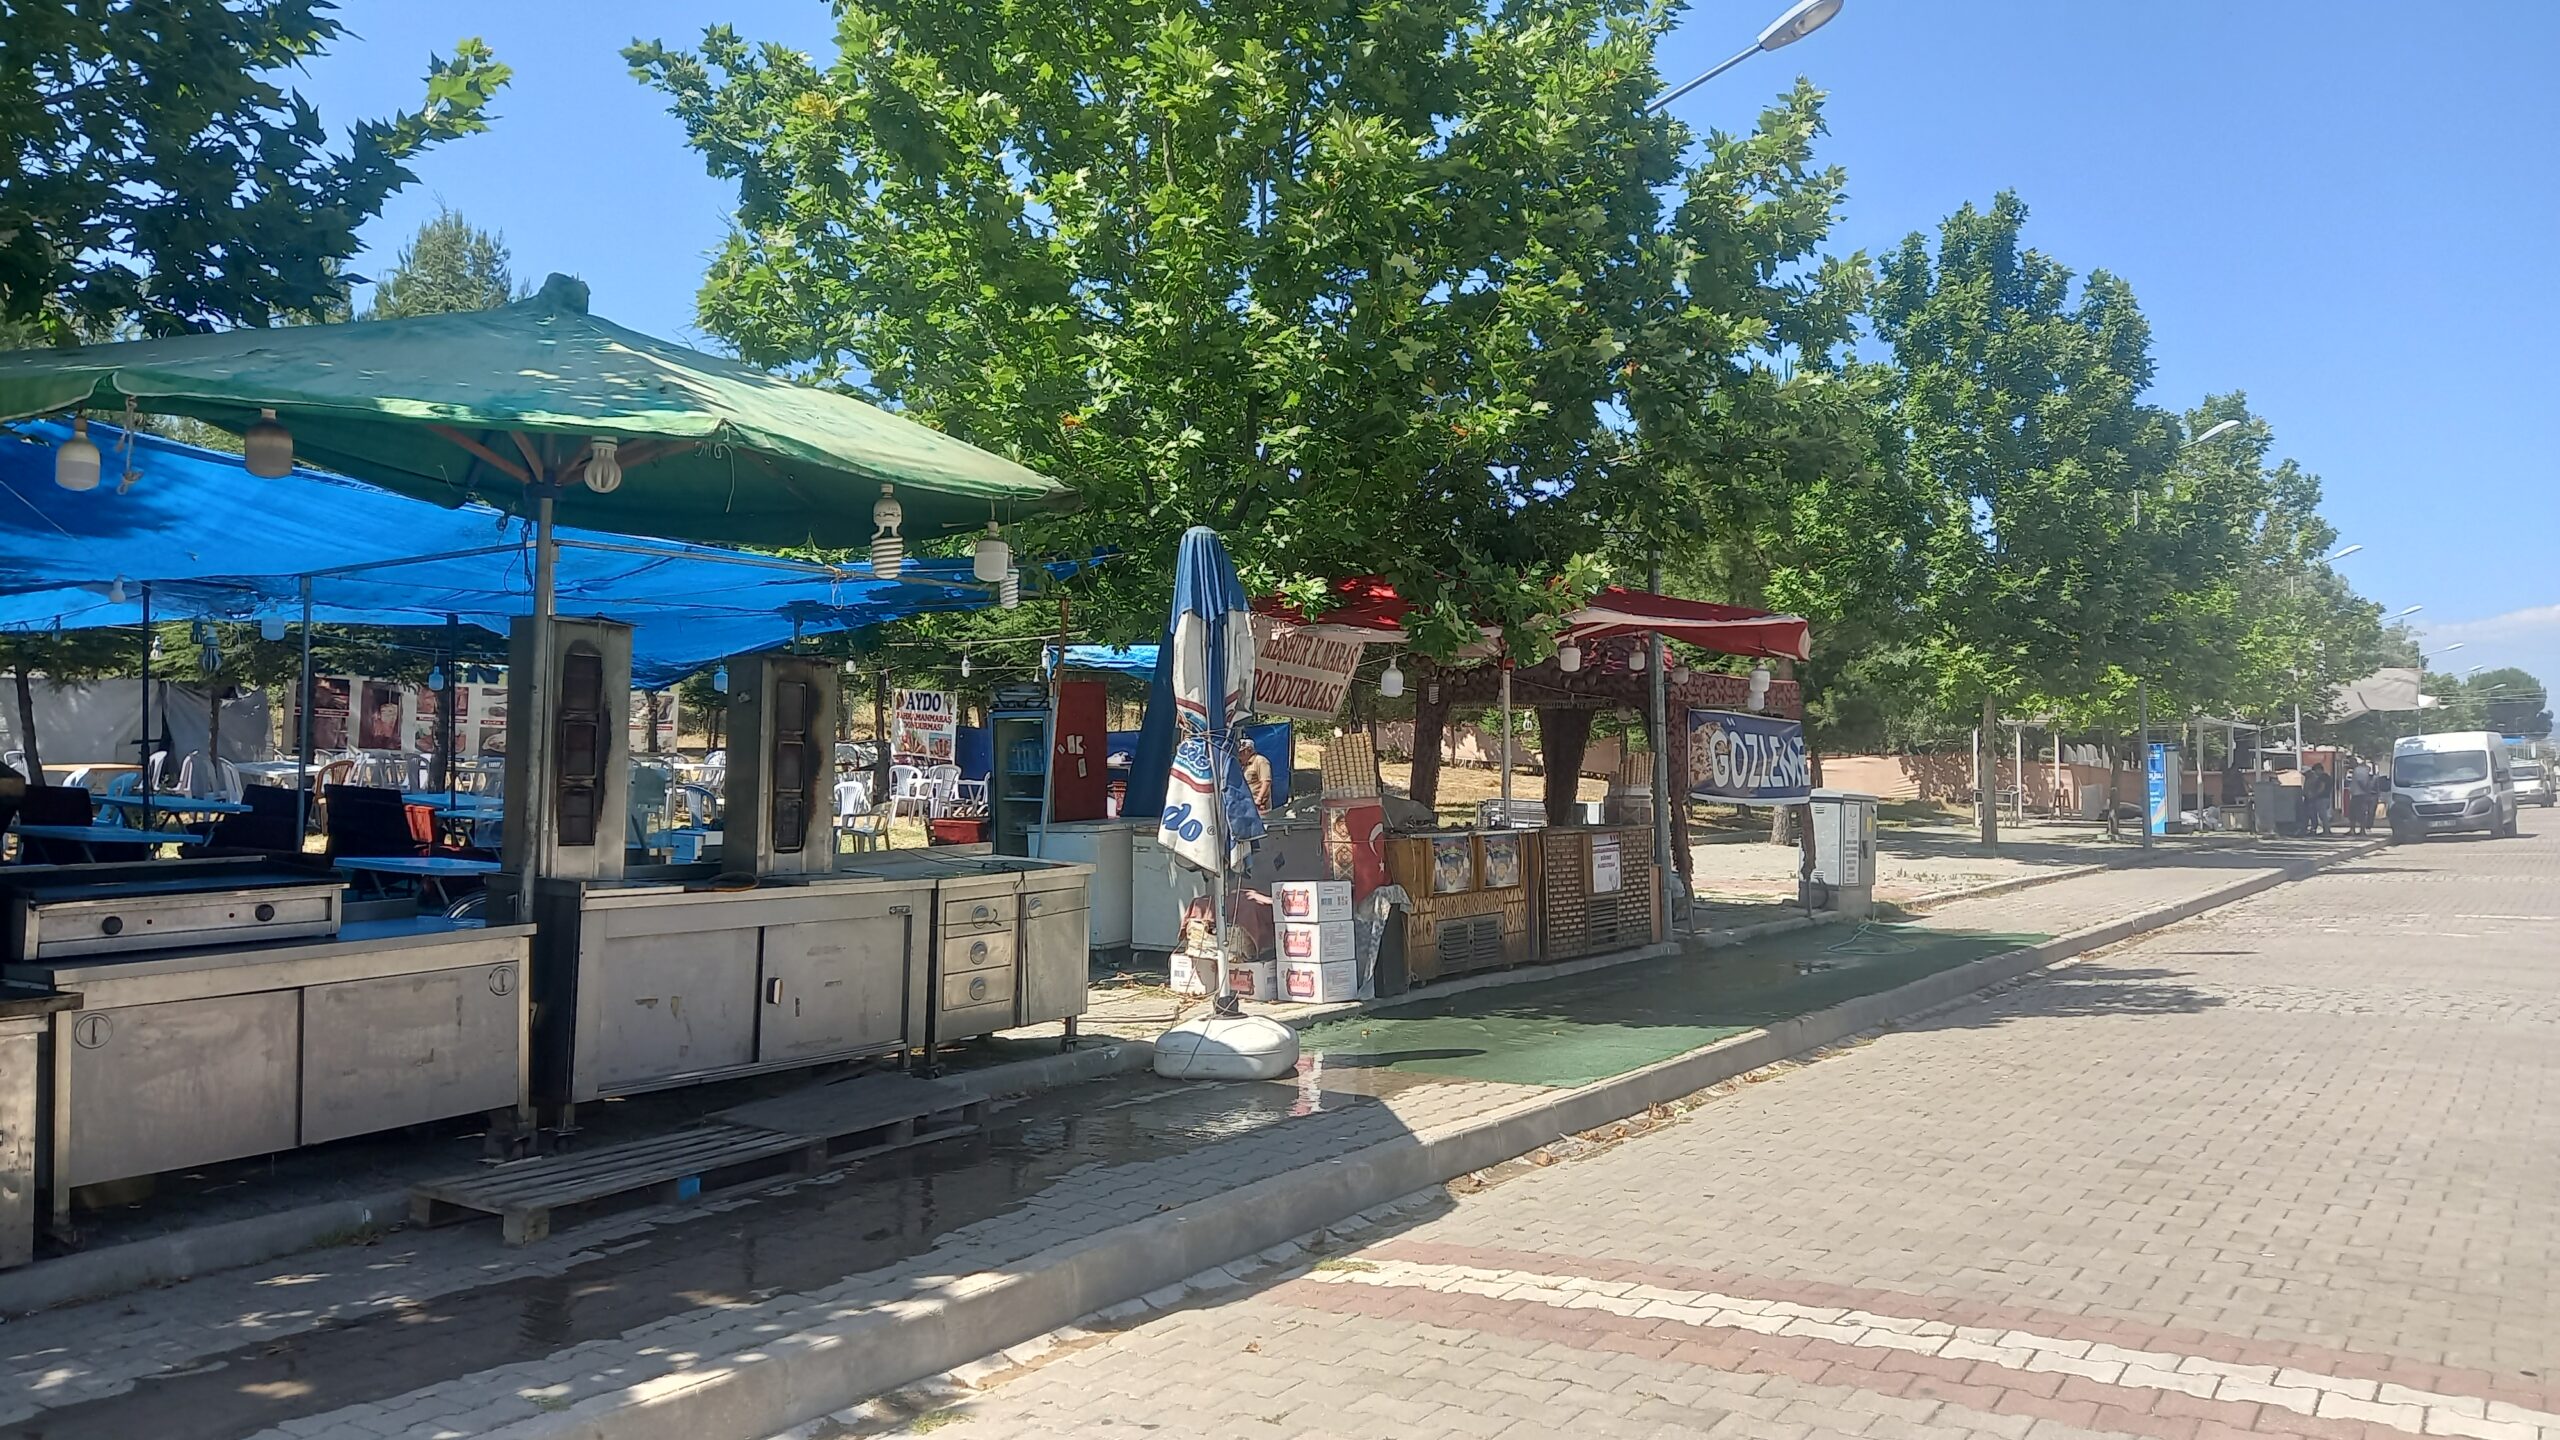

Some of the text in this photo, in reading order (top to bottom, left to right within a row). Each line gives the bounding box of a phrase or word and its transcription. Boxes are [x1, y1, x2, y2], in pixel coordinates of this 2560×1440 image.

[1261, 632, 1360, 680] MEŞHUR K.MARAŞ
[906, 691, 942, 713] AYDO
[1709, 717, 1812, 789] GÖZLEME
